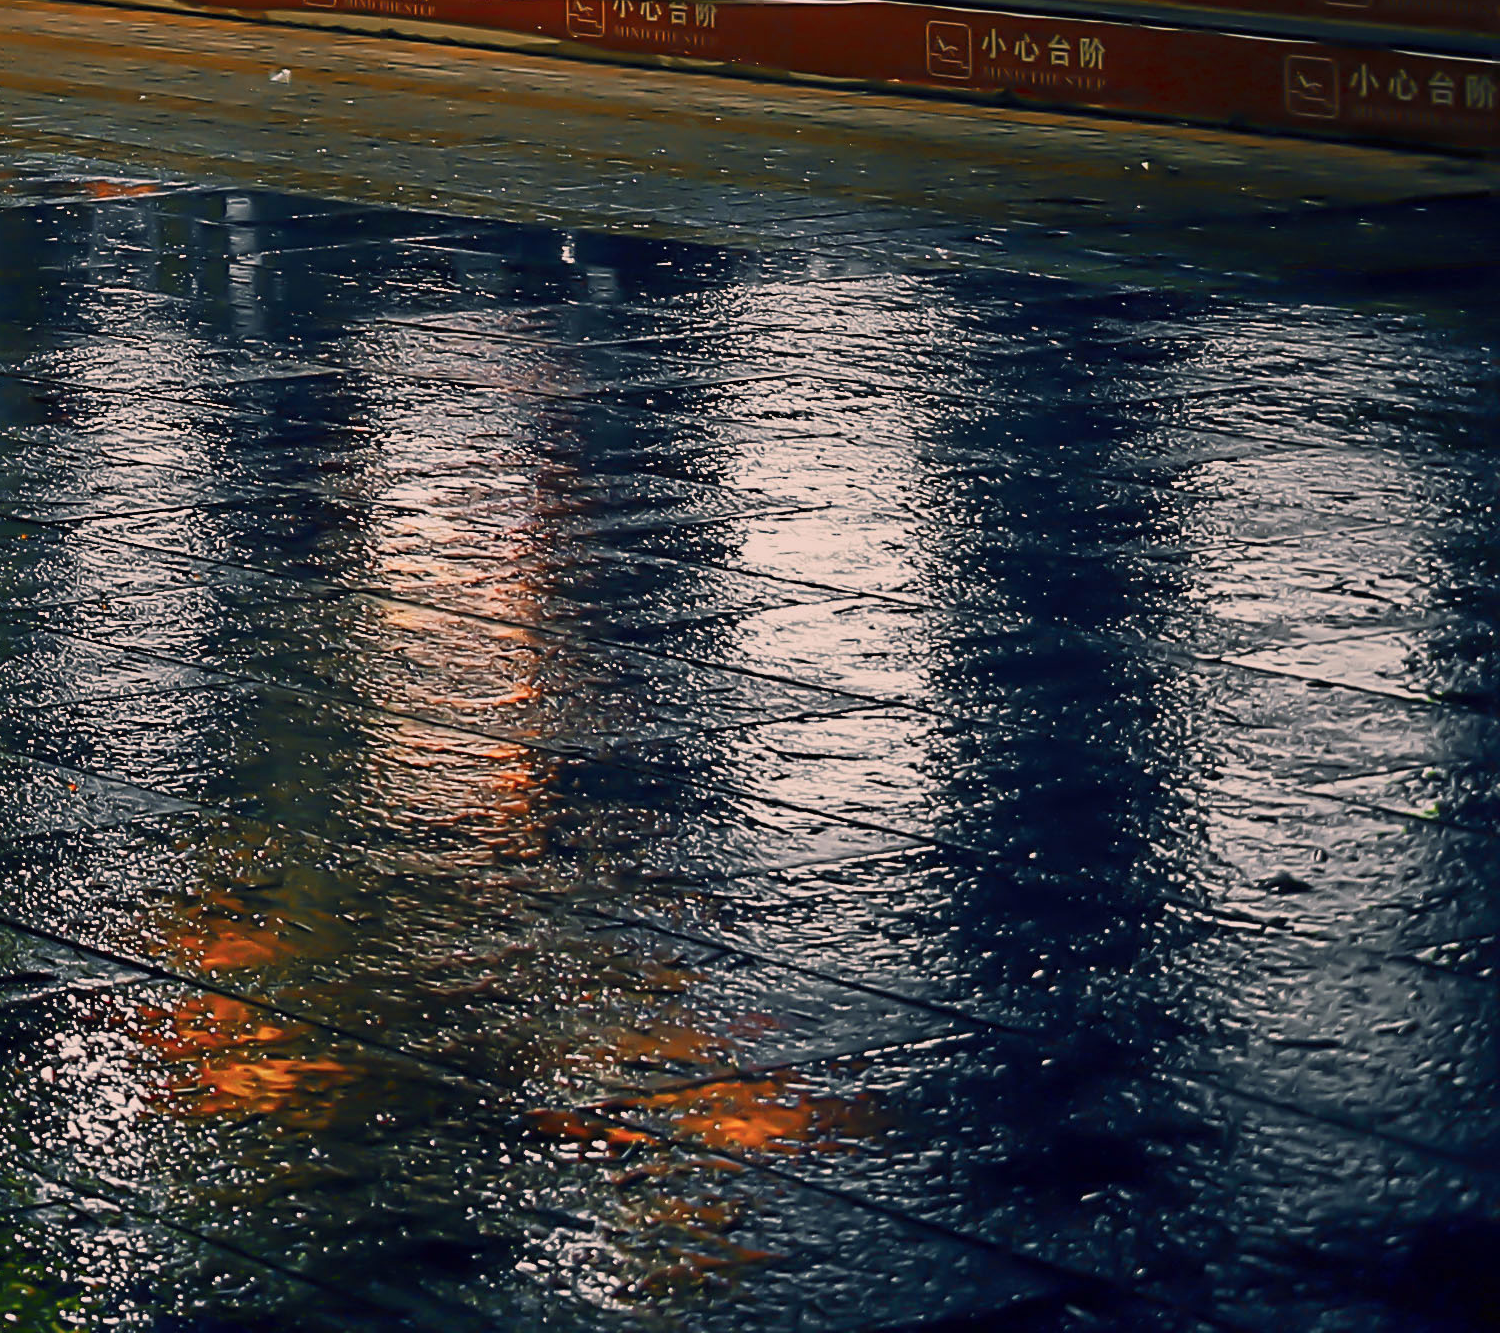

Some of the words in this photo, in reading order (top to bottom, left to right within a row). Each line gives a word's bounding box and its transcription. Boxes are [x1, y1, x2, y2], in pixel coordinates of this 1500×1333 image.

[612, 0, 717, 29] 小心台阶
[981, 28, 1106, 69] 小心台阶
[1349, 63, 1497, 110] 小心台阶
